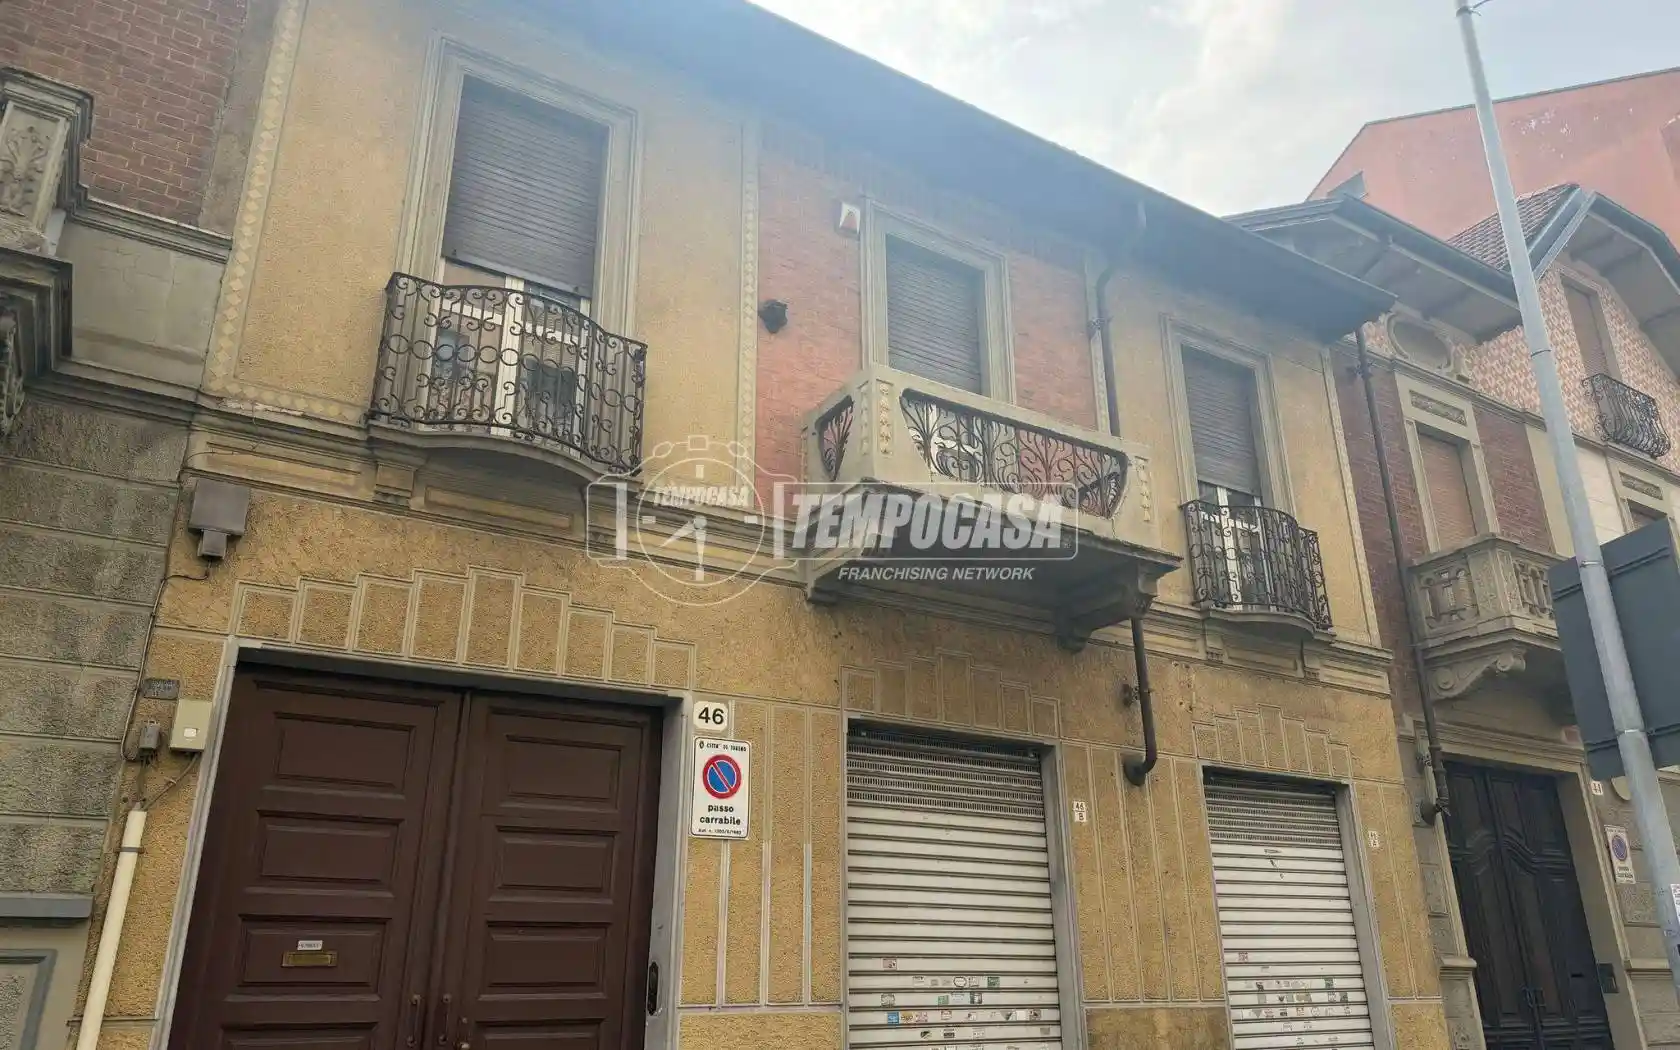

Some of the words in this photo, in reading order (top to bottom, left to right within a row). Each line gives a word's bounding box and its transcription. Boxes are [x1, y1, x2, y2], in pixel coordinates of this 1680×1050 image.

[698, 706, 725, 725] 46
[707, 804, 734, 813] passo
[699, 815, 741, 826] carrabile
